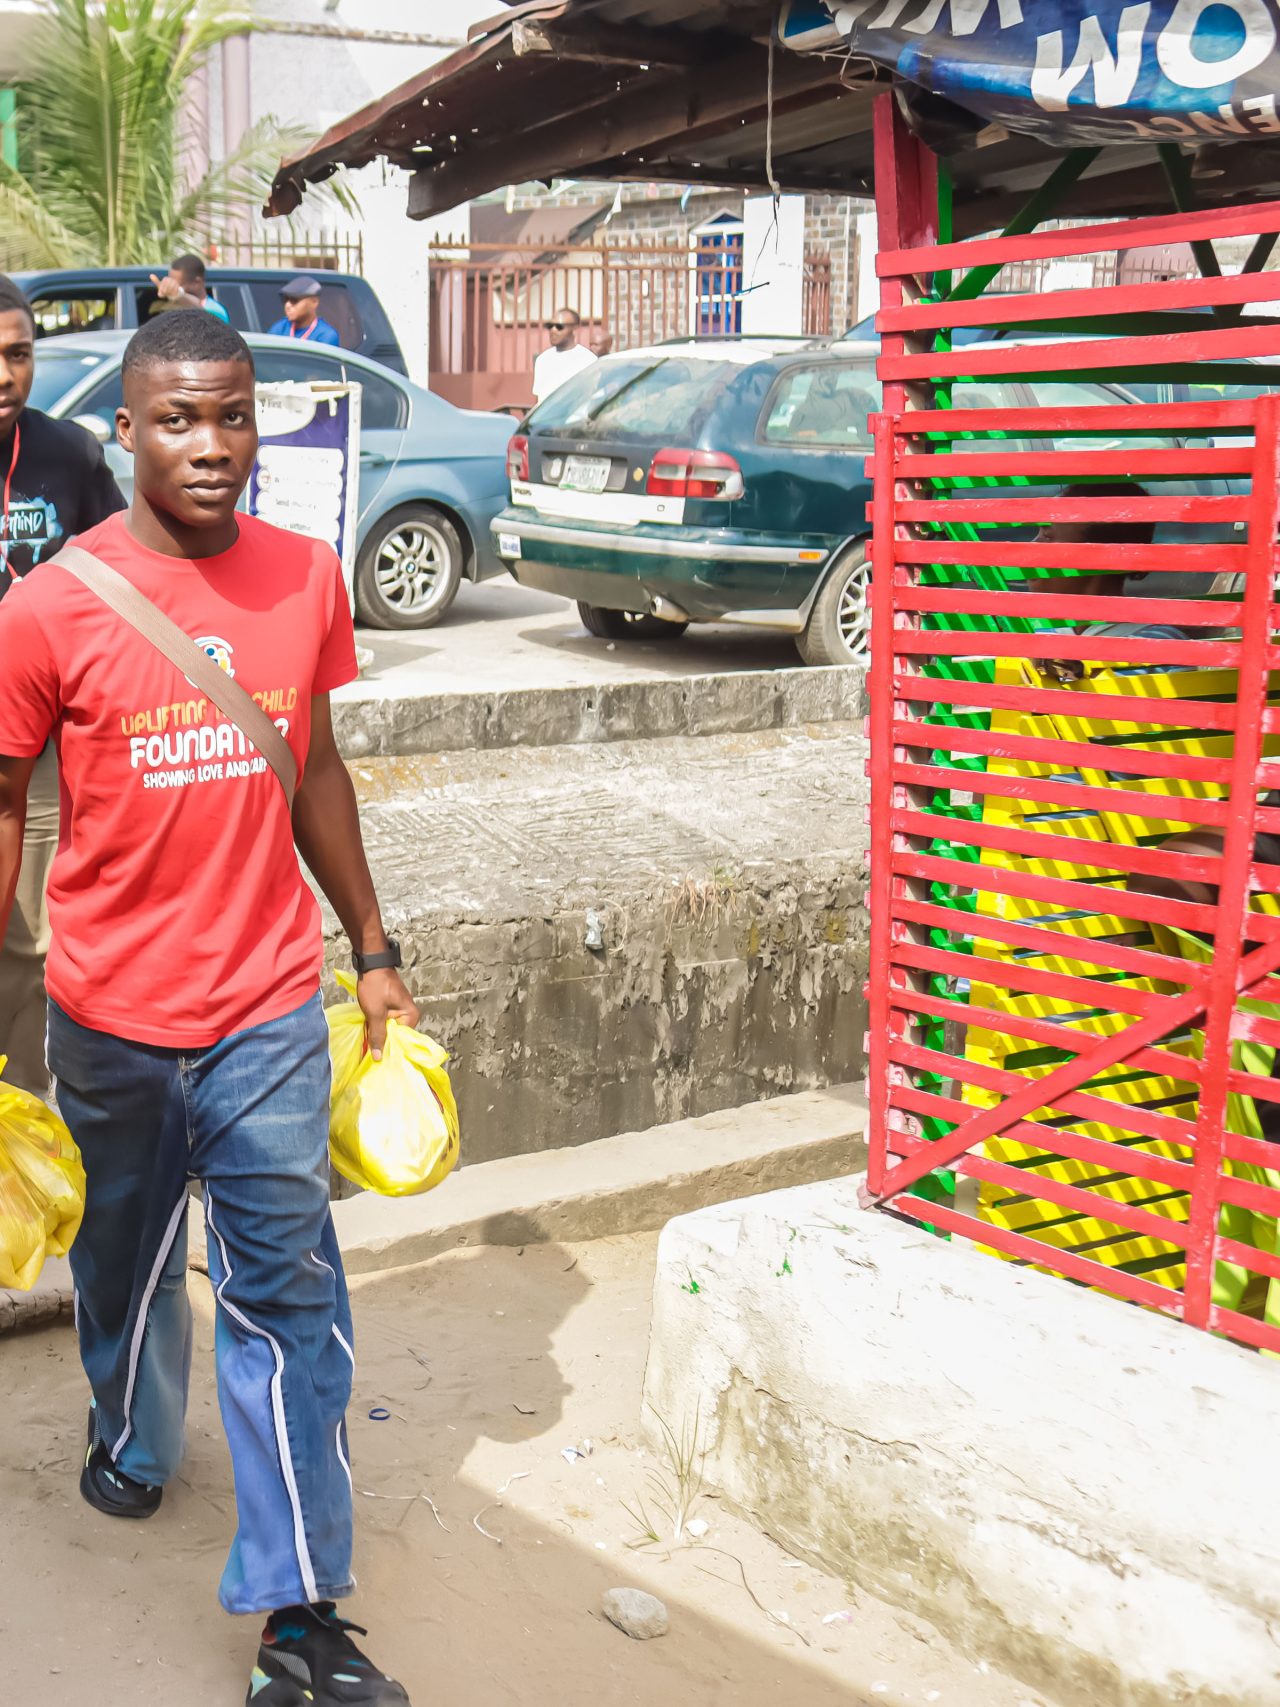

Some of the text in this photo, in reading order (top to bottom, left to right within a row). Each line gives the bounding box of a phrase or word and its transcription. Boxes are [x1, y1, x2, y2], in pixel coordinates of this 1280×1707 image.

[121, 698, 207, 736] UPLIFTING
[143, 767, 195, 789] SHOWING
[197, 763, 223, 783] LOVE
[225, 760, 250, 778] AND
